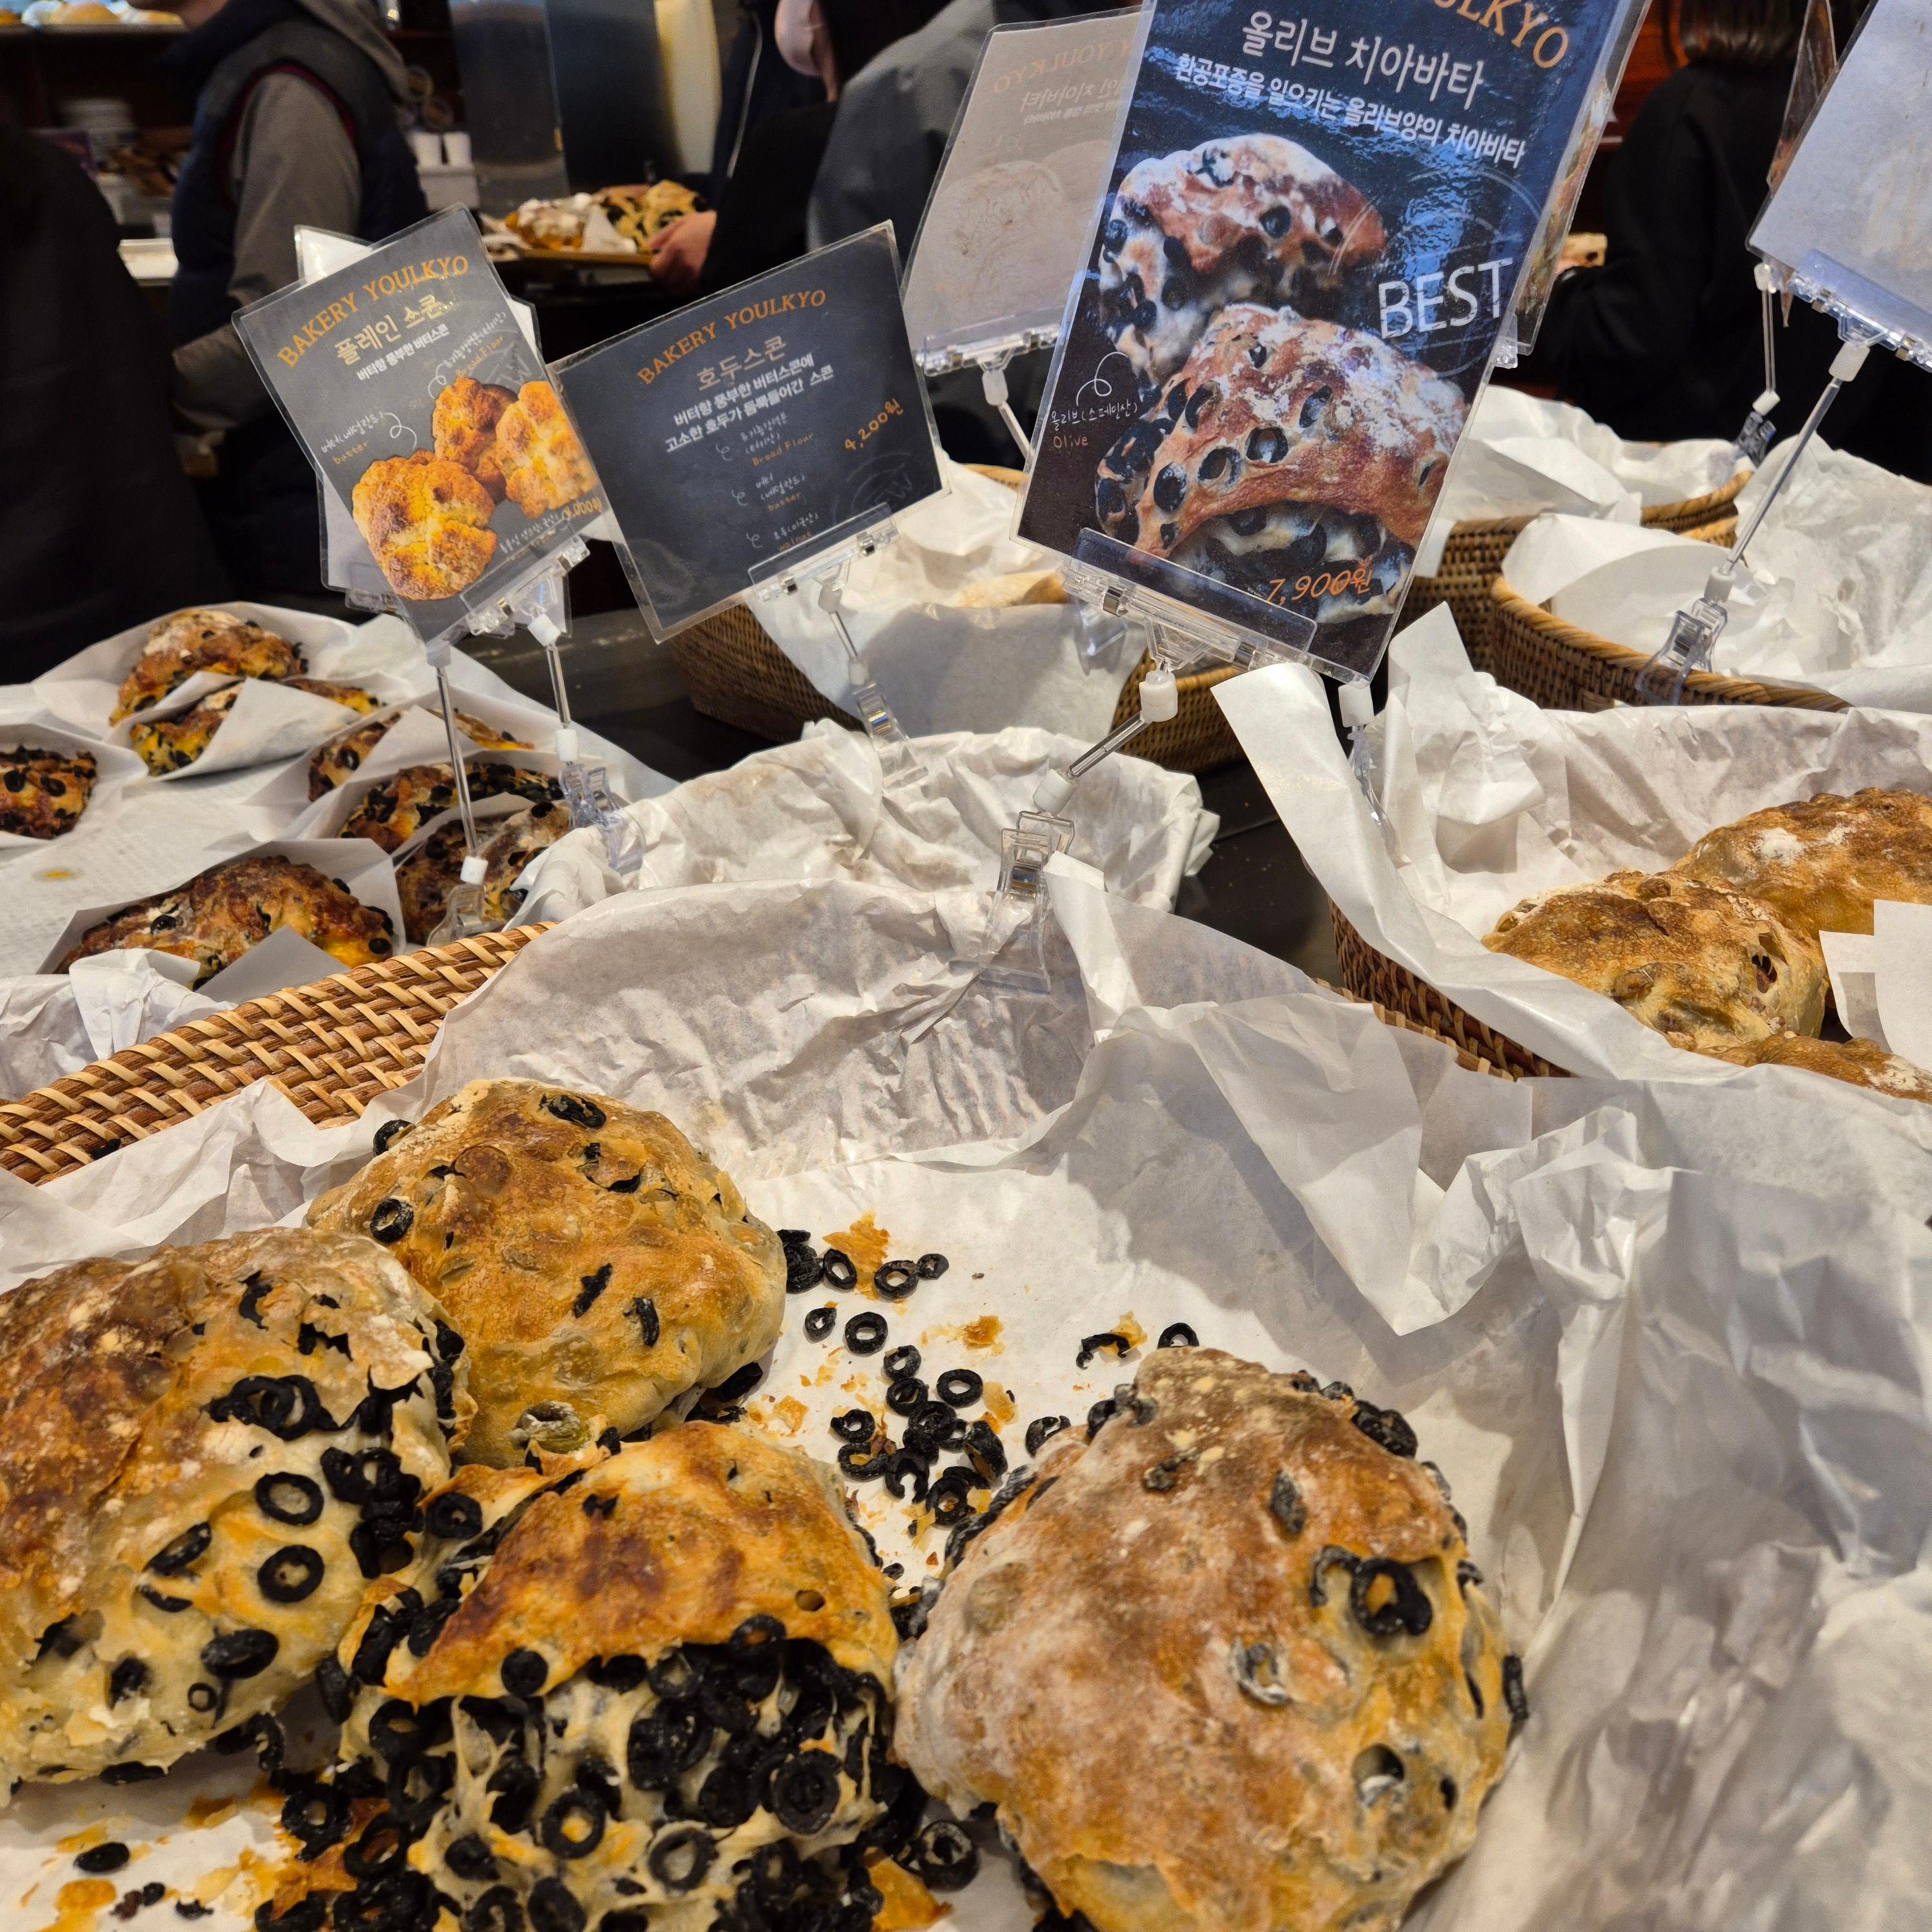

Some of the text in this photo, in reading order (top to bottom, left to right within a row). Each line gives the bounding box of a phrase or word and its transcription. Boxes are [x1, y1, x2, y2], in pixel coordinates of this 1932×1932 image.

[1242, 11, 1485, 110] 올리브 치아바타
[1175, 53, 1526, 169] 환공포증을 일으키는 올리브양의 치아바타
[277, 256, 469, 368] BAKERY YOULKYO
[334, 294, 444, 365] 플레인 스콘
[1379, 258, 1513, 339] BEST
[386, 342, 415, 367] 풍부한
[637, 289, 826, 385] BAKERY YOULKYO
[697, 335, 786, 391] 호두스콘
[664, 424, 704, 453] 고소한
[704, 406, 743, 435] 호두가
[809, 364, 834, 386] 스콘
[673, 353, 815, 426] 버터향 풍부한 버터스콘에
[752, 445, 783, 467] Bread
[1053, 435, 1089, 448] Olive
[767, 491, 802, 512] butter
[1266, 568, 1373, 606] 7,900원
